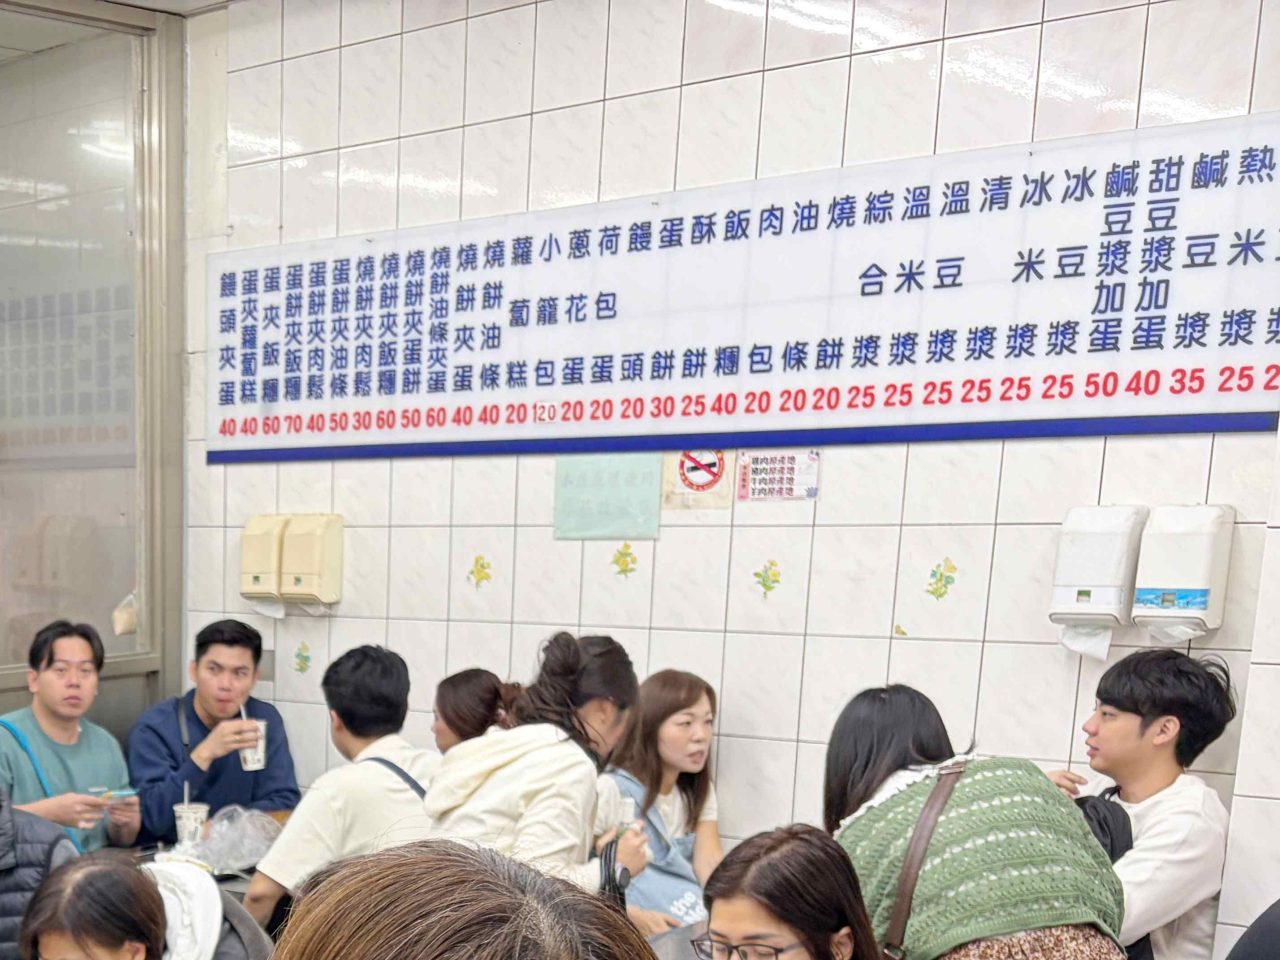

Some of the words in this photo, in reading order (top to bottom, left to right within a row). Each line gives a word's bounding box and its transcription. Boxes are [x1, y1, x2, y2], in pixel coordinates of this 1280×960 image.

[219, 272, 237, 406] 饅頭夾蛋
[329, 258, 350, 399] 蛋餅夾油條
[401, 250, 425, 394] 燒餅夾蛋餅
[427, 246, 451, 394] 燒餅油條夾蛋
[452, 243, 478, 392] 燒餅夾蛋
[479, 240, 505, 390] 燒餅油條
[534, 234, 561, 386] 小籠包
[590, 225, 621, 384] 荷包蛋
[621, 222, 652, 381] 饅頭
[650, 217, 684, 380] 蛋餅
[682, 213, 717, 378] 酥餅
[748, 207, 784, 374] 肉包
[782, 202, 819, 372] 油條
[815, 196, 856, 370] 燒餅
[220, 419, 236, 436] 40
[241, 417, 258, 435] 40
[262, 416, 280, 434] 60
[285, 415, 303, 432] 70
[307, 414, 326, 432] 40
[330, 412, 348, 432] 50
[353, 411, 372, 430] 30
[376, 410, 396, 430] 60
[402, 408, 422, 429] 50
[425, 407, 447, 428] 60
[452, 405, 474, 426] 40
[478, 404, 500, 425] 40
[506, 403, 528, 424] 20
[561, 400, 585, 422] 20
[590, 400, 614, 421] 20
[621, 397, 645, 420] 20
[650, 395, 676, 419] 30
[681, 394, 706, 416] 25
[711, 392, 737, 415] 40
[744, 390, 771, 414] 20
[780, 388, 807, 413] 20
[812, 386, 841, 412] 20
[847, 385, 876, 409] 25
[883, 383, 913, 407] 25
[922, 380, 953, 406] 25
[960, 378, 992, 403] 25
[999, 376, 1032, 402] 25
[1041, 374, 1074, 400] 25
[1084, 371, 1119, 398] 50
[1124, 369, 1161, 396] 40
[1169, 368, 1205, 395] 35
[1218, 365, 1254, 393] 25
